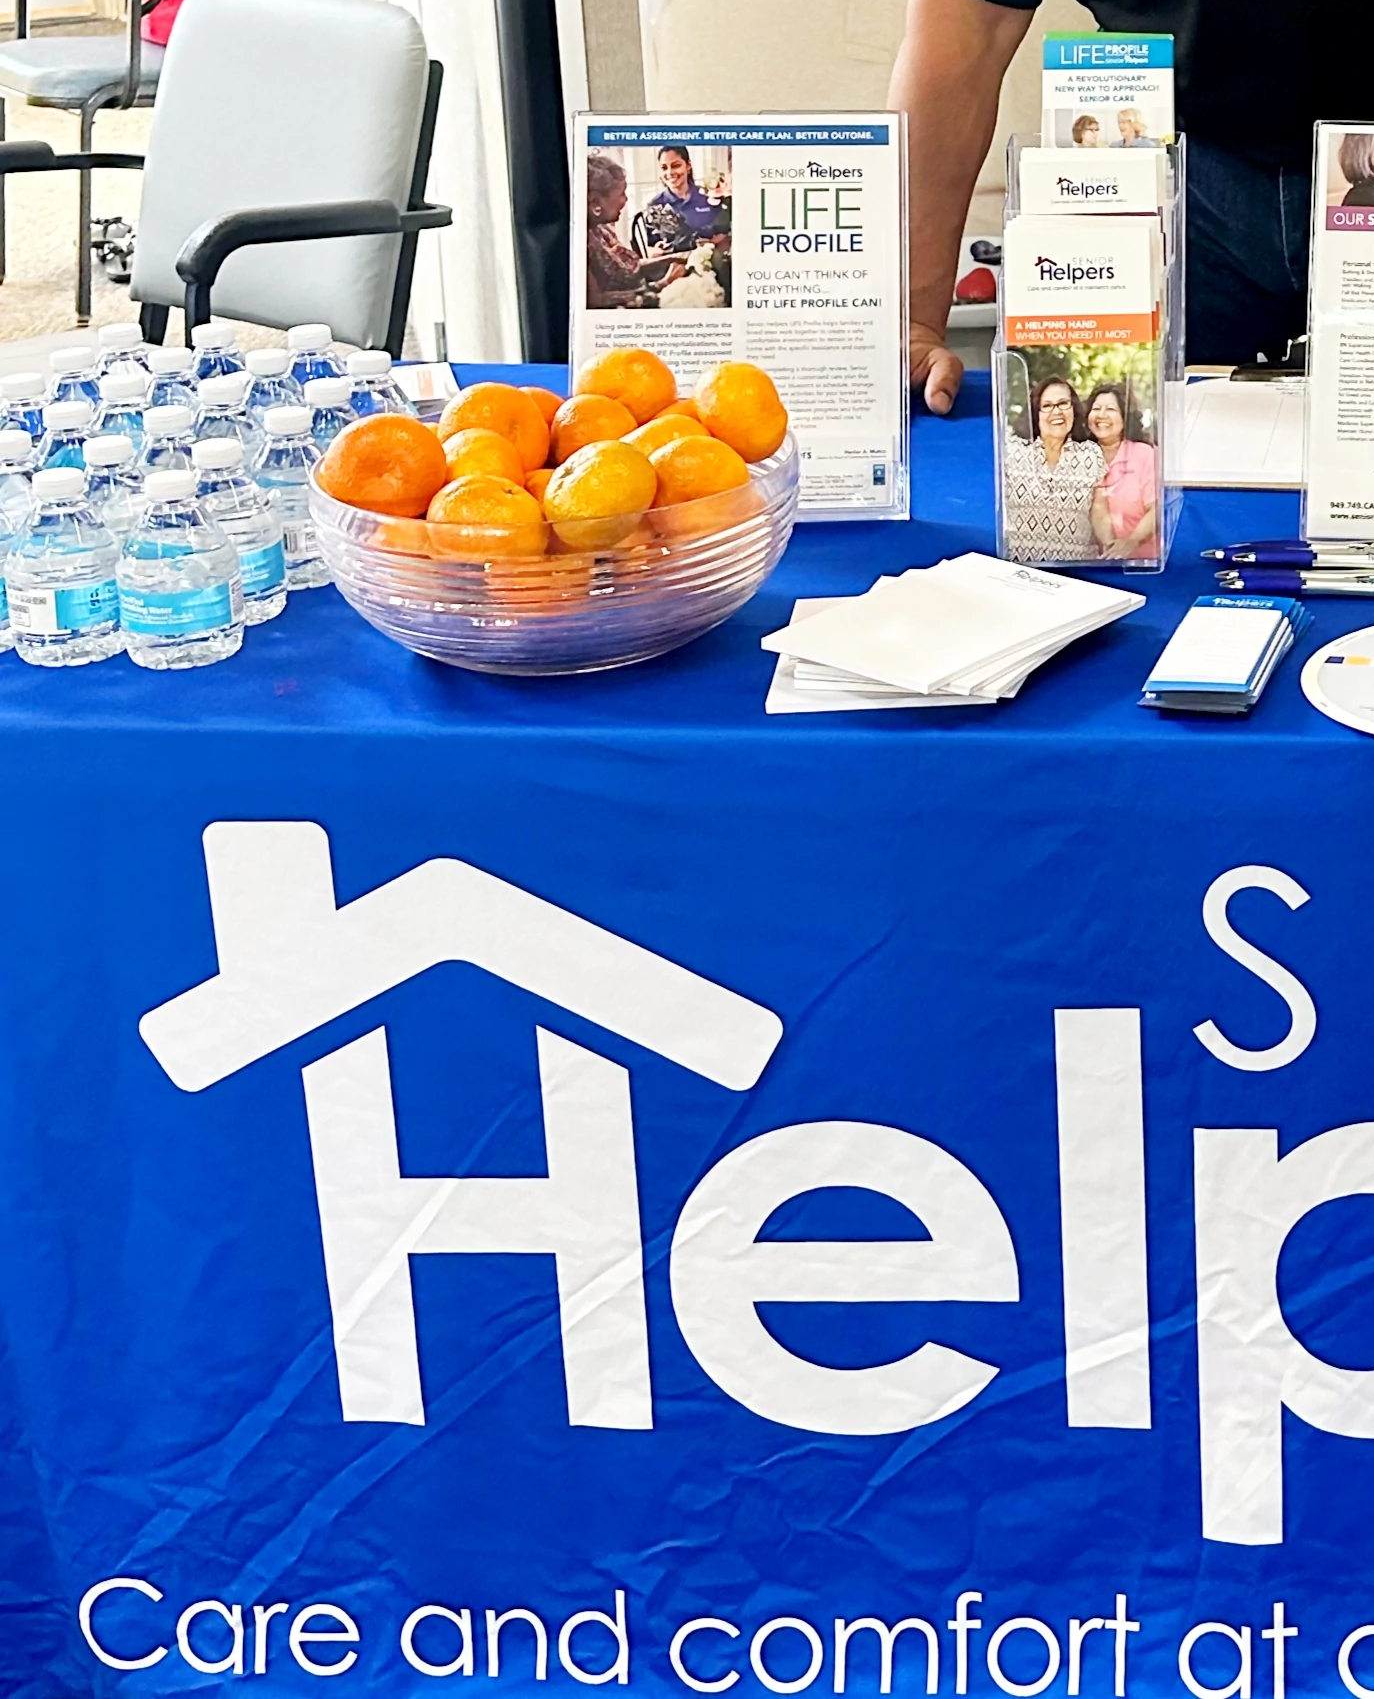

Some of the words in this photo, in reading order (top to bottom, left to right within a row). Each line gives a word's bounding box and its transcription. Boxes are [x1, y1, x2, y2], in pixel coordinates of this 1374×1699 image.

[1061, 45, 1105, 64] LIFE
[1105, 45, 1149, 54] PROFILE
[604, 132, 637, 140] BETTER
[761, 168, 805, 178] SENIOR
[810, 164, 862, 180] Helpers
[1060, 183, 1118, 198] Helpers
[760, 188, 863, 230] LIFE
[1333, 213, 1364, 226] OUR
[761, 234, 863, 253] PROFILE
[1072, 257, 1114, 265] SENIOR
[747, 271, 771, 280] YOU
[814, 270, 849, 279] THINK
[853, 270, 868, 279] OF
[1040, 264, 1115, 284] Helpers
[747, 300, 769, 308] BUT
[774, 300, 796, 308] LIFE
[801, 299, 848, 308] PROFILE
[1015, 332, 1044, 340] WHEN
[1069, 331, 1093, 339] NEED
[1105, 330, 1132, 338] MOST
[79, 1578, 360, 1678] Care
[400, 1590, 630, 1686] and
[669, 1591, 1140, 1699] comfort
[1179, 1601, 1299, 1699] at
